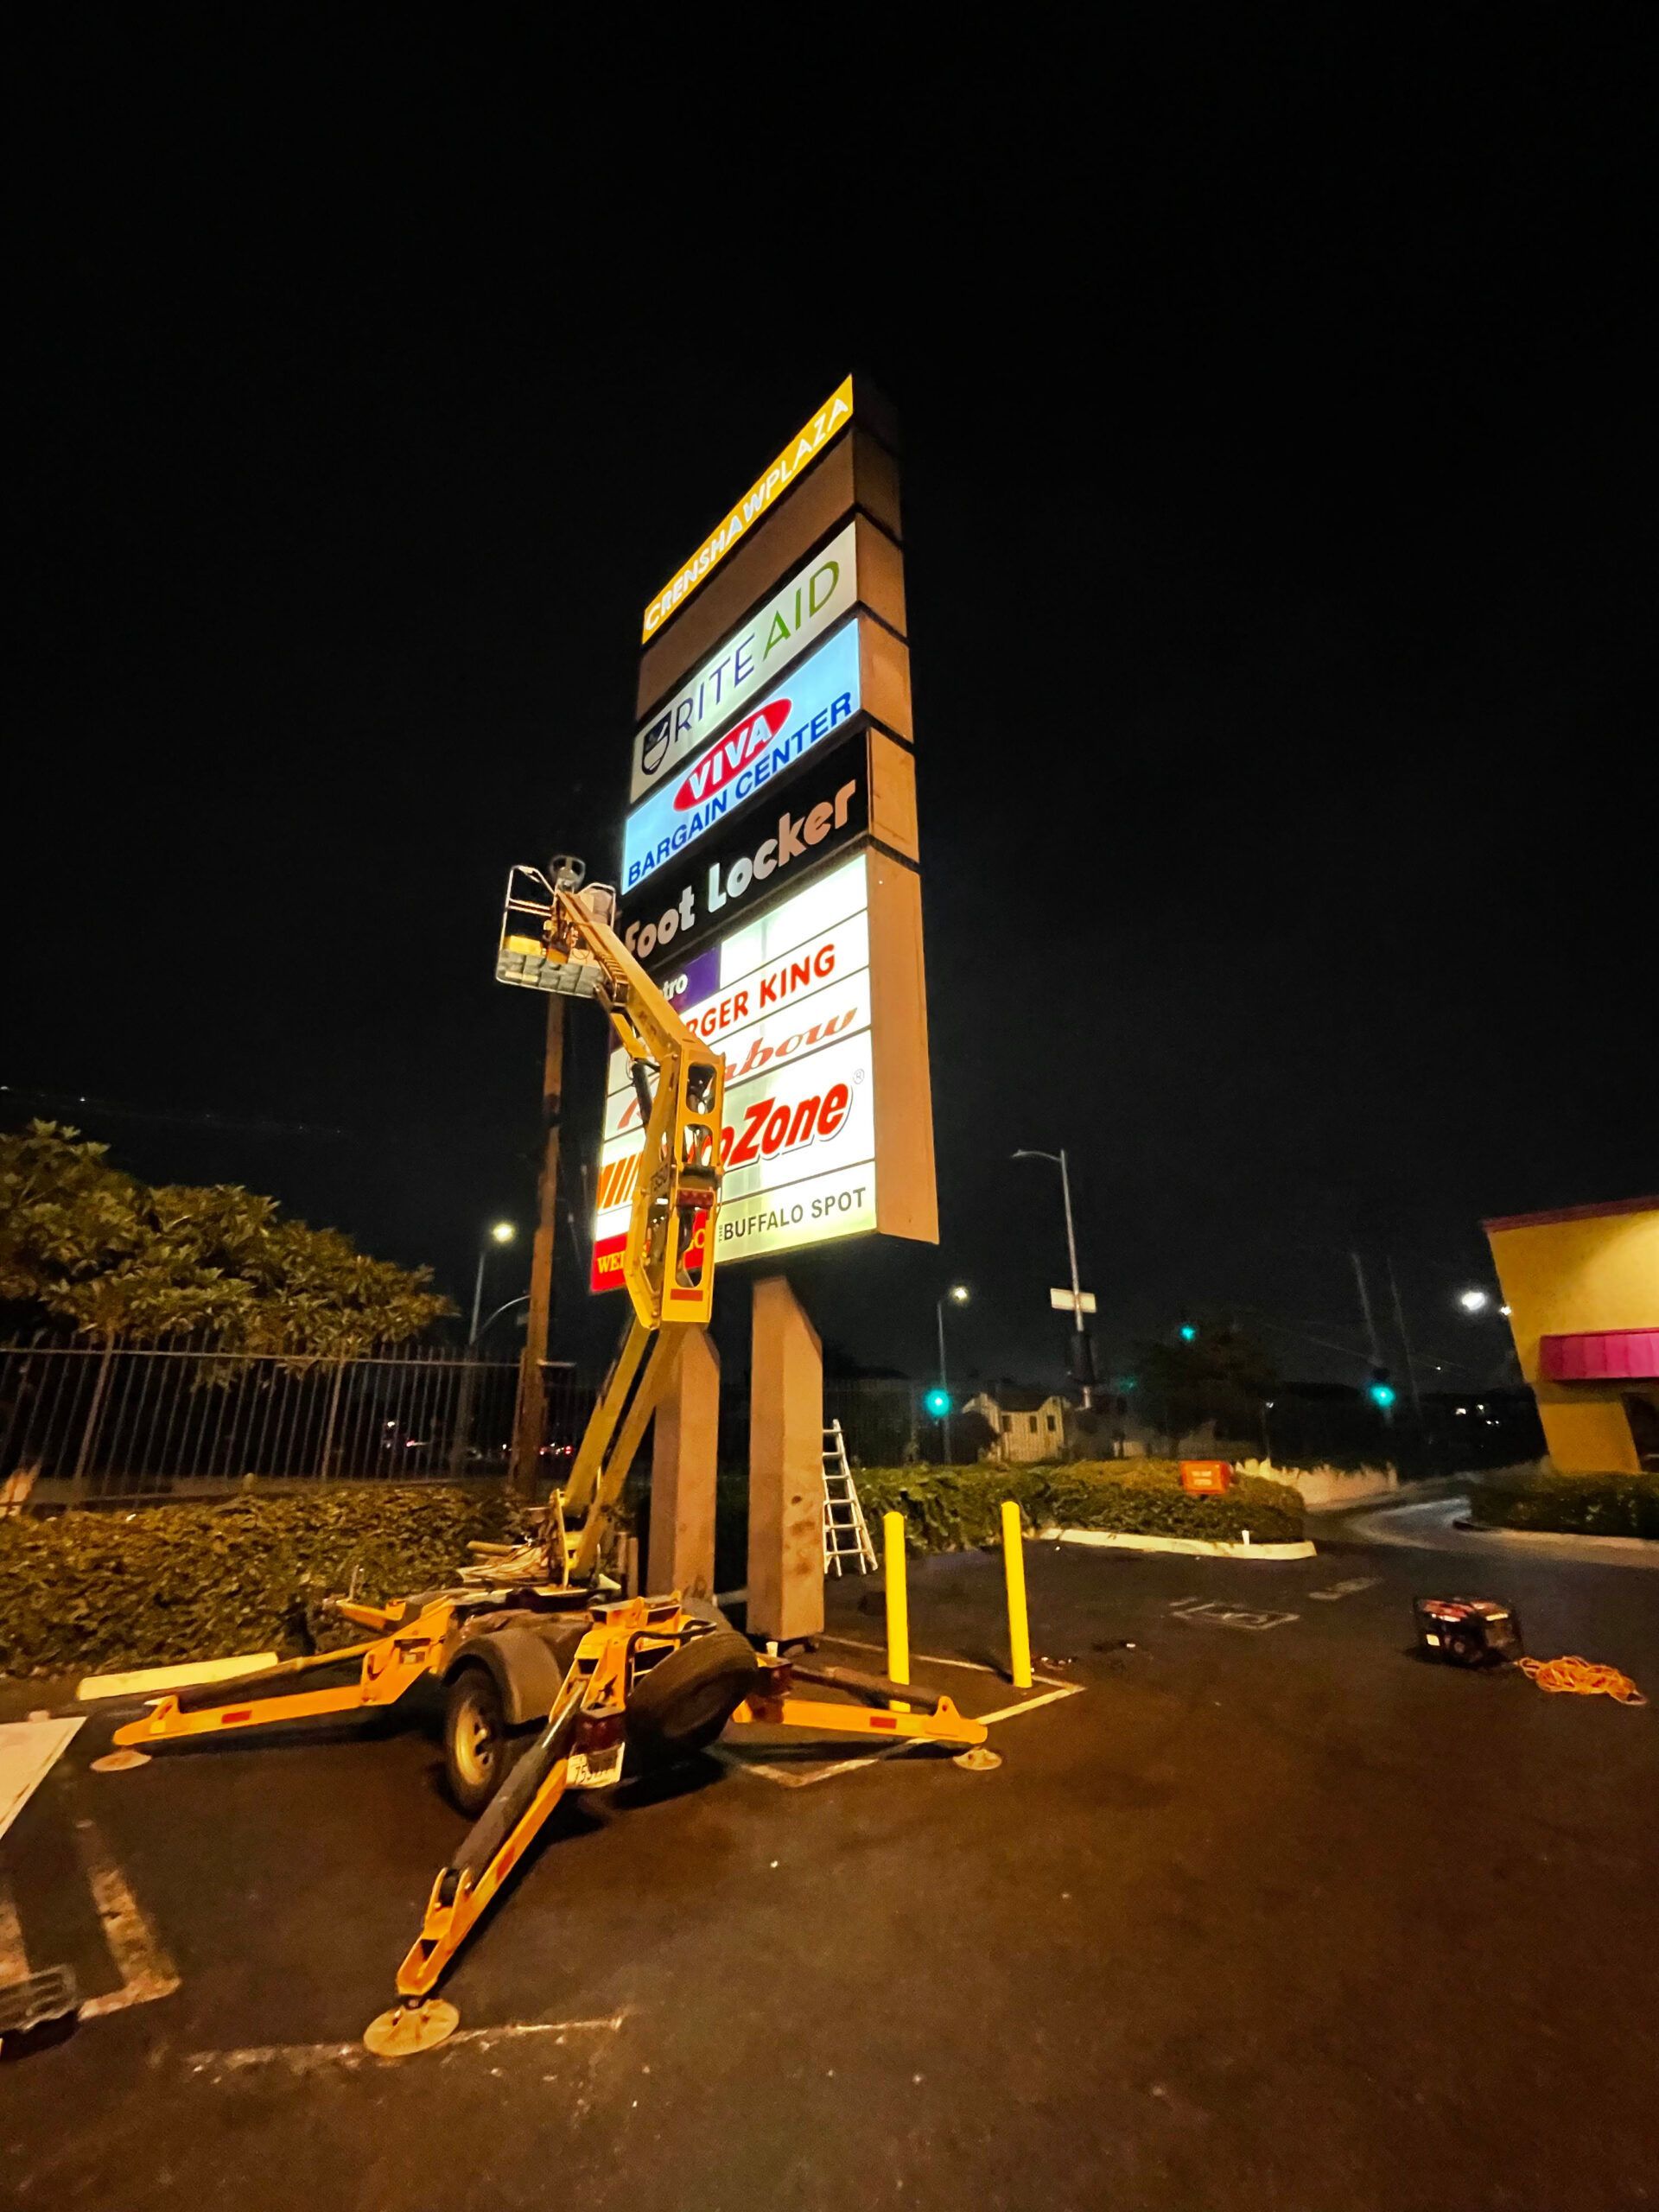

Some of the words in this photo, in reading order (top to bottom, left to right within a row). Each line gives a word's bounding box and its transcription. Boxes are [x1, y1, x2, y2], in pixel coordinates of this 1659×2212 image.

[674, 632, 755, 743] RITE
[762, 560, 840, 661] AID
[627, 790, 728, 887] BARGAIN
[734, 691, 852, 800] CENTER
[688, 715, 772, 801] VIVA
[708, 779, 856, 913] Locker
[661, 974, 689, 1000] tro
[685, 990, 748, 1037] RGER
[760, 944, 835, 1008] KING
[724, 1204, 804, 1241] BUFFALO
[810, 1186, 867, 1219] SPOT
